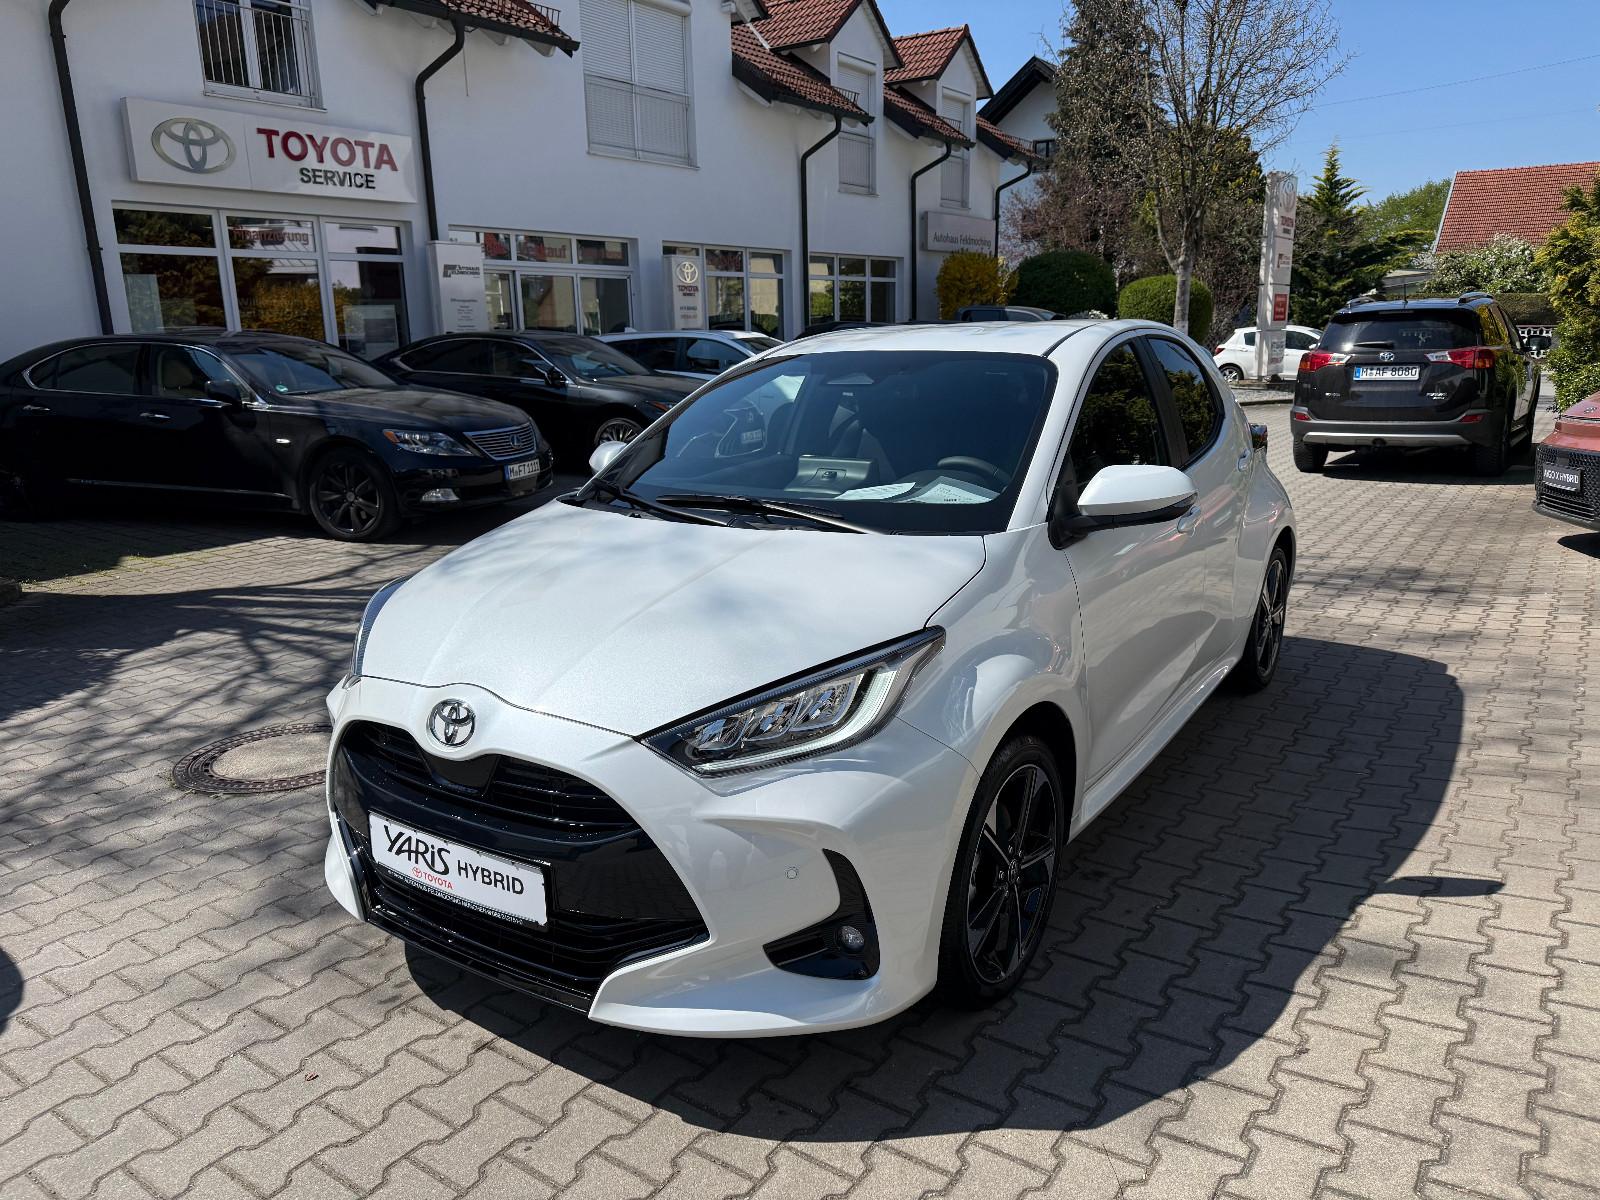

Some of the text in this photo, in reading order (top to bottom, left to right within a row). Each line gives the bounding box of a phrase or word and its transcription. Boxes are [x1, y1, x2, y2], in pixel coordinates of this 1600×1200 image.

[257, 127, 399, 172] TOYOTA
[299, 167, 376, 190] SERVICE
[423, 871, 454, 890] TOYOTA
[457, 859, 524, 895] HYBRID
